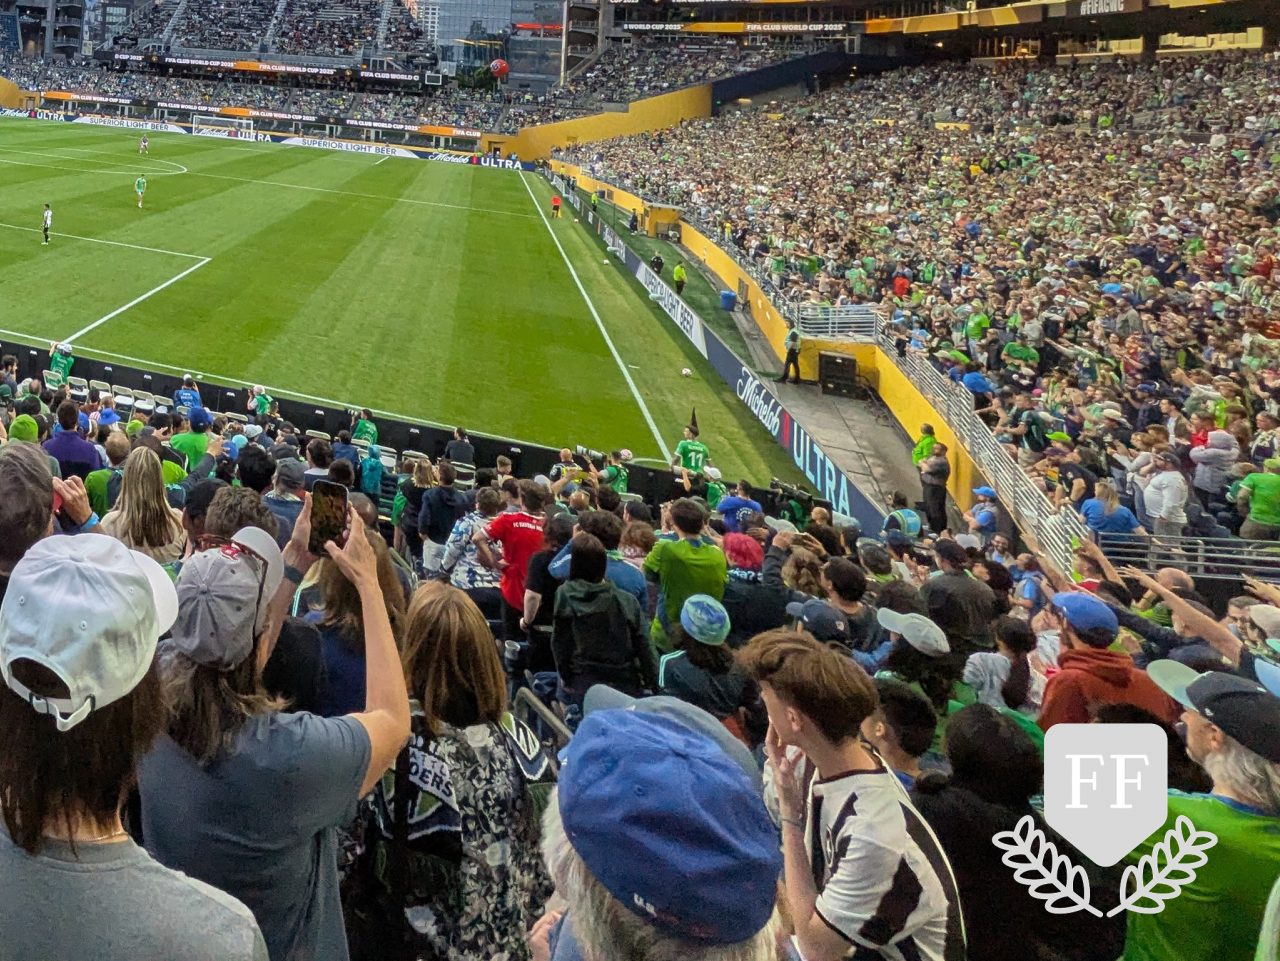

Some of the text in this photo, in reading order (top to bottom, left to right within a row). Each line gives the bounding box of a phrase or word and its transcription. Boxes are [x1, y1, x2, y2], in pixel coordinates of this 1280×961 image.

[361, 71, 374, 79] FIFA
[36, 112, 65, 122] ULTRA
[90, 118, 124, 127] SUPERIOR
[238, 131, 272, 142] ULTRA
[302, 139, 397, 156] SUPERIOR LIGHT BEER
[428, 152, 522, 170] Michelob ULTRA
[736, 367, 850, 517] Michelob ULTRA
[688, 452, 704, 467] 11
